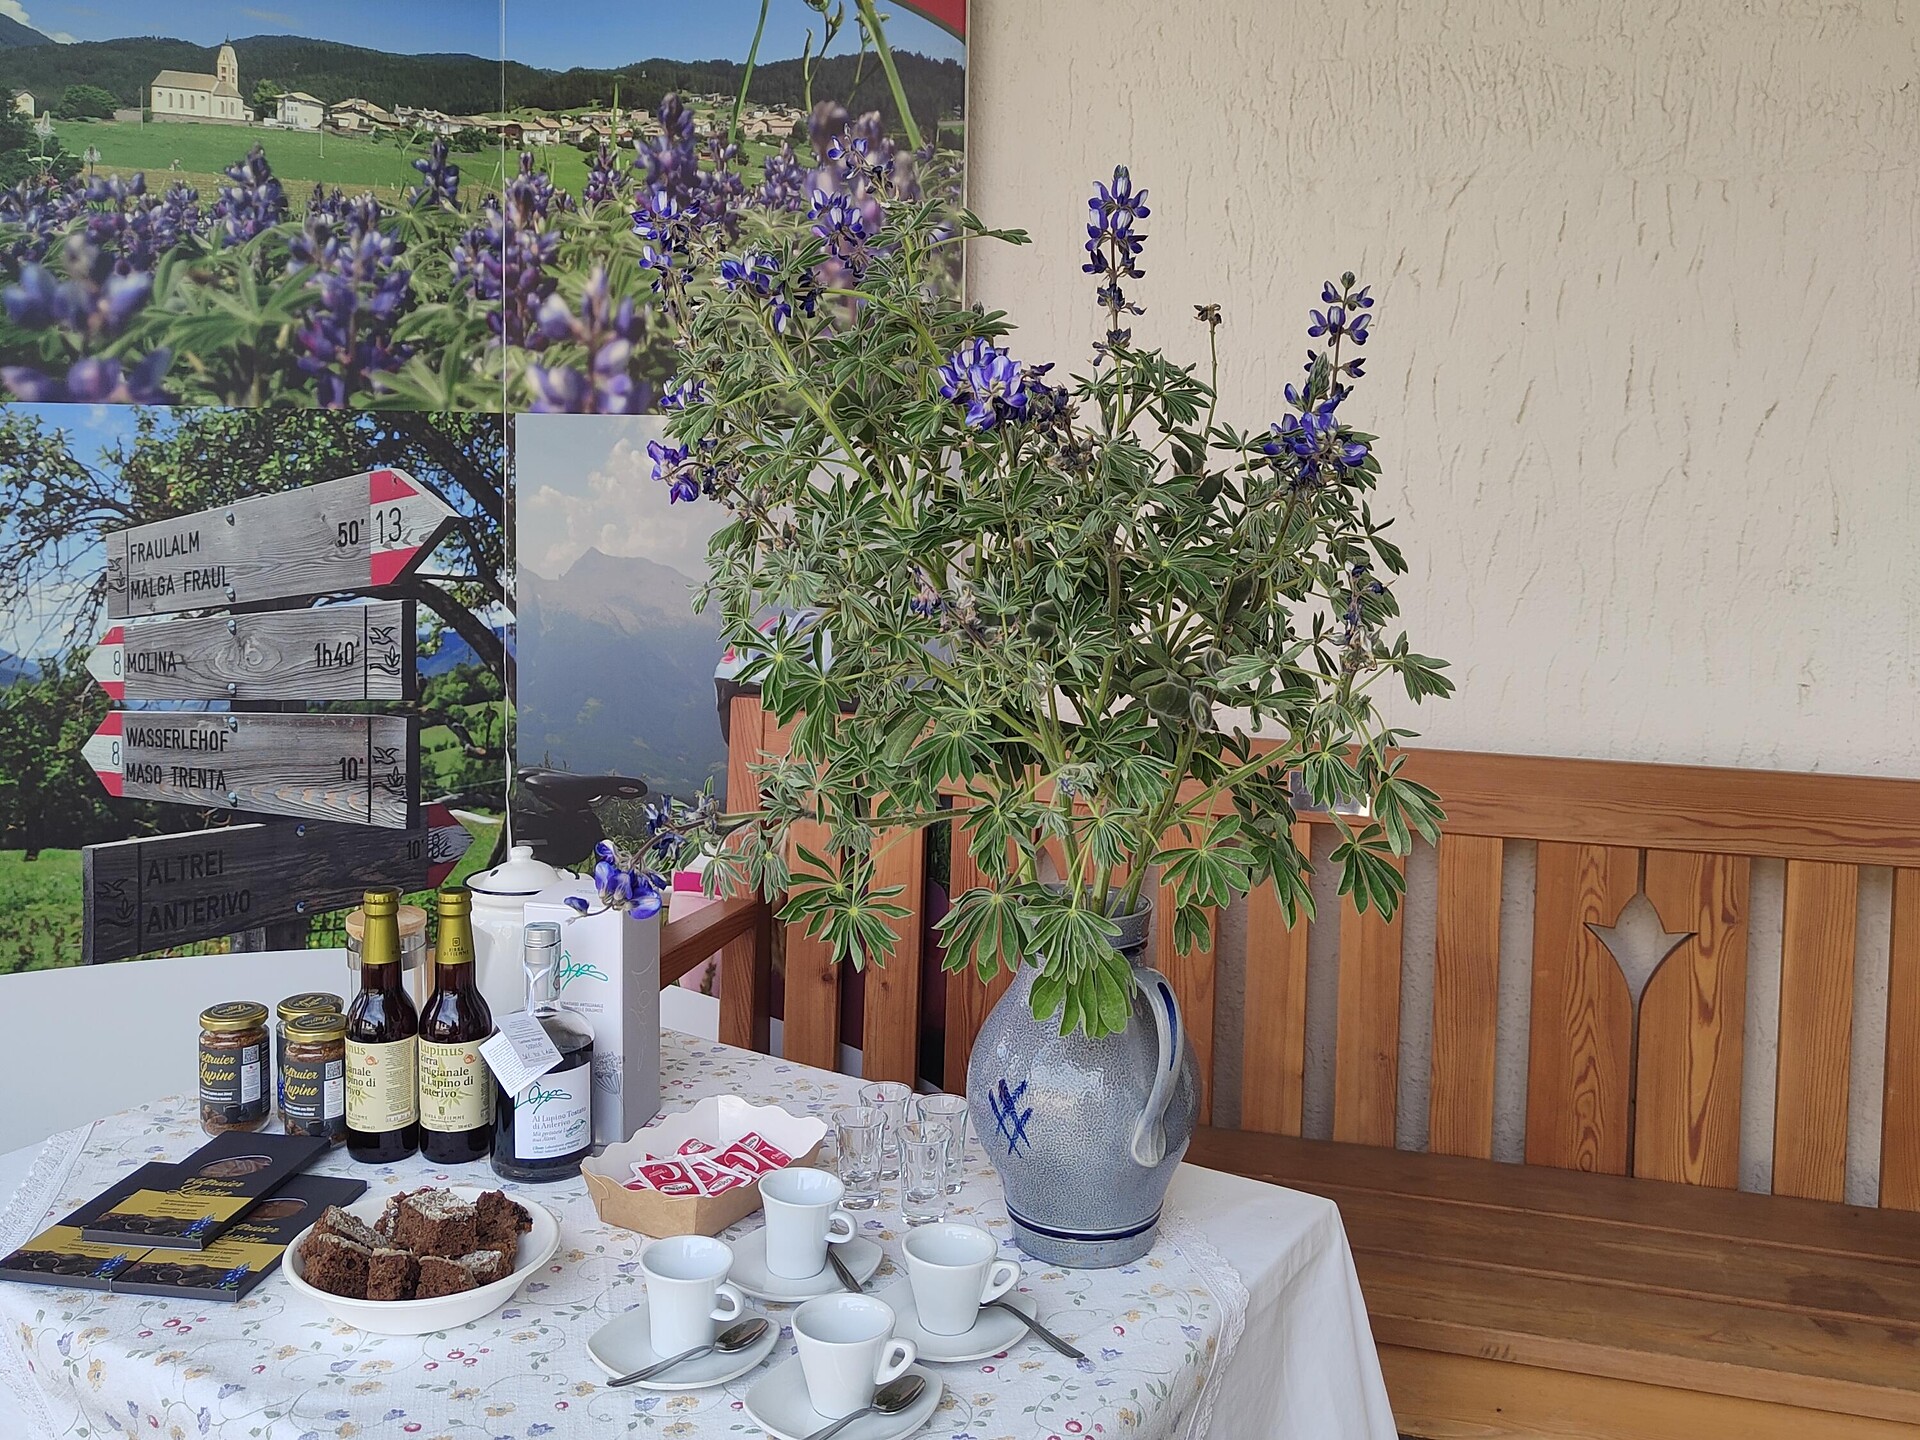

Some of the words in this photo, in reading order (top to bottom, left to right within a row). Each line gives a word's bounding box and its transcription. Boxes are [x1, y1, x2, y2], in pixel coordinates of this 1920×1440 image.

[338, 519, 364, 547] 50'
[376, 507, 401, 544] 13
[130, 531, 199, 564] FRAULALM
[131, 574, 175, 600] MALGA
[184, 566, 230, 593] FRAUL
[113, 651, 121, 675] 8
[127, 651, 176, 673] MOLINA
[126, 727, 229, 751] WASSERLEHOF
[111, 741, 120, 765] 8
[126, 763, 162, 784] MASO
[171, 766, 227, 791] TRENTA
[146, 850, 223, 886] ALTREI
[146, 889, 250, 933] ANTERIVO
[420, 1041, 464, 1056] Lupinus
[199, 1061, 237, 1086] Lupine
[366, 1078, 376, 1087] di
[428, 1076, 461, 1089] Lupino
[464, 1076, 474, 1086] di
[284, 1075, 320, 1100] Lupine
[421, 1085, 457, 1098] Anterivo
[541, 1119, 571, 1129] Anterivo
[542, 1112, 566, 1123] Lupino
[568, 1106, 587, 1118] Tostato
